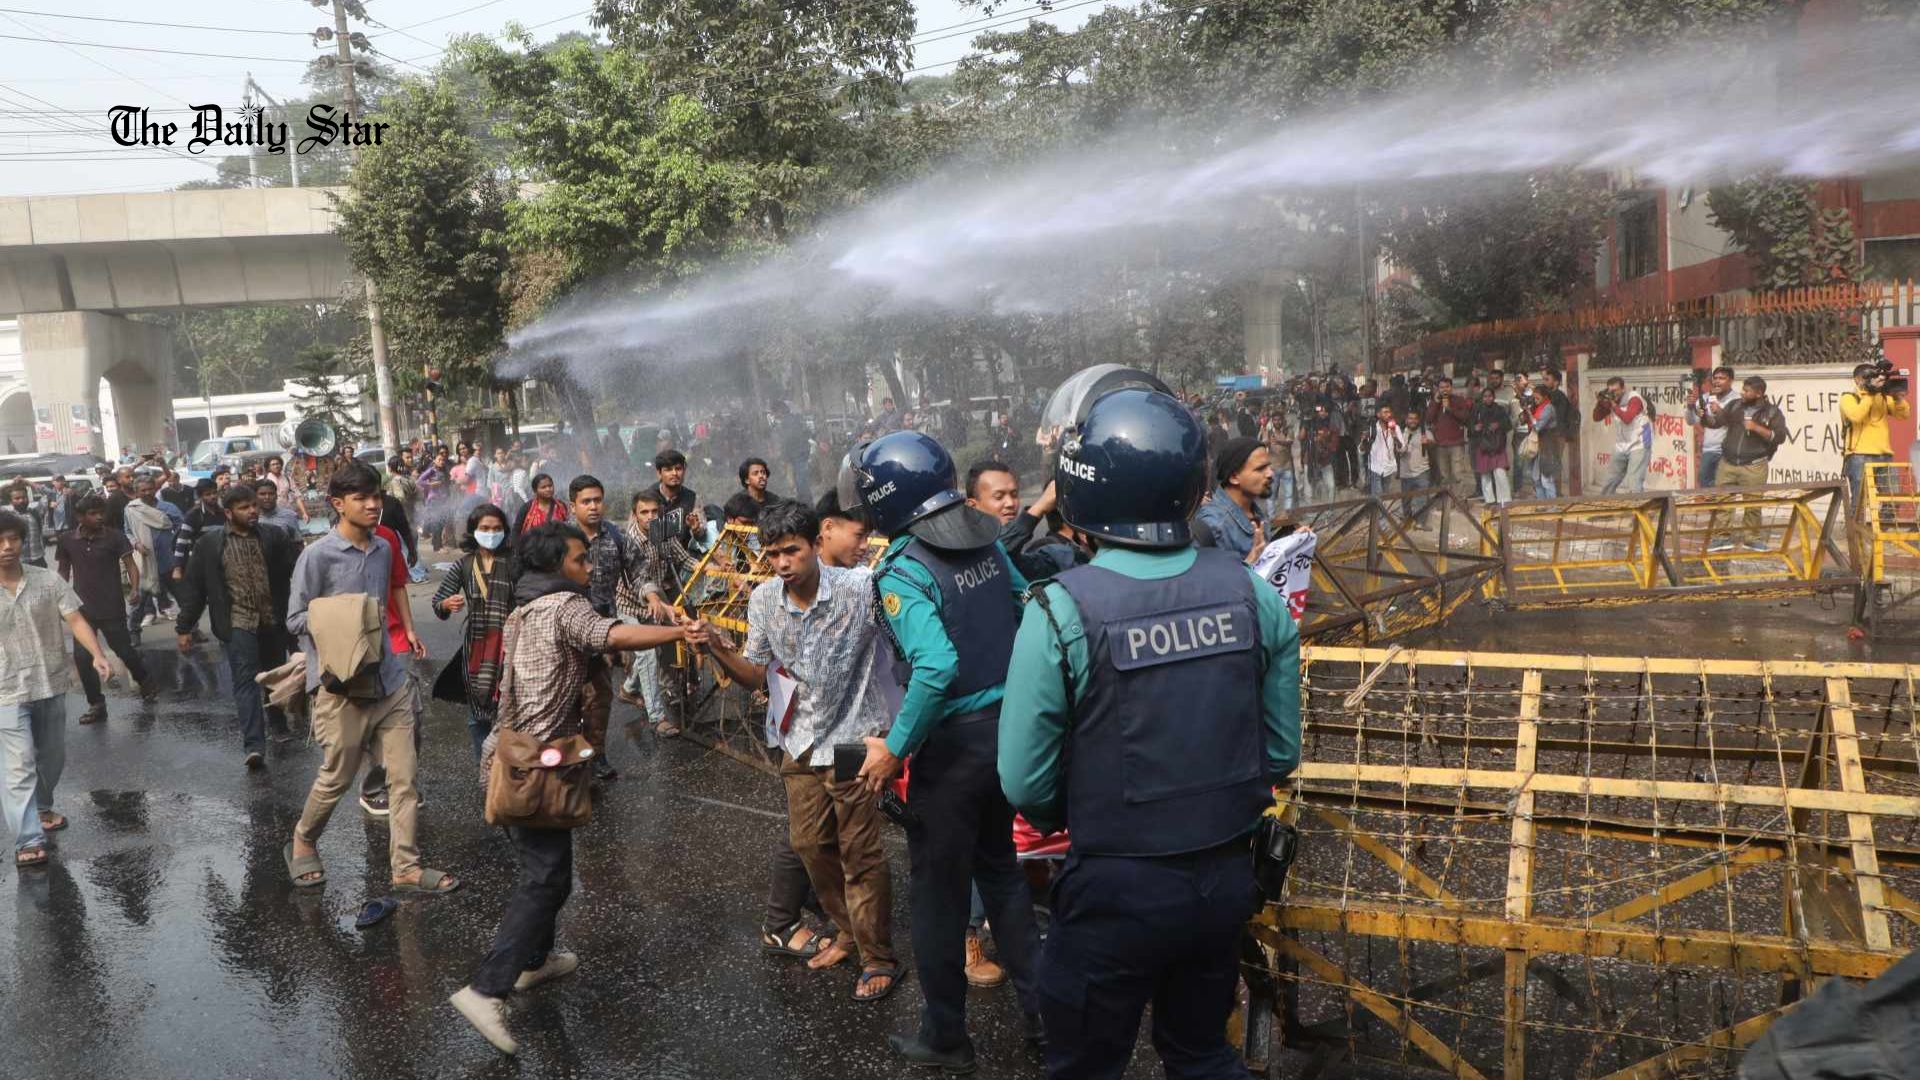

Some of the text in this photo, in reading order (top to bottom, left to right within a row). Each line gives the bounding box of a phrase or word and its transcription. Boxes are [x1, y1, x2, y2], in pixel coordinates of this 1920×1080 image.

[1771, 392, 1839, 413] VE LIF
[1785, 424, 1818, 453] VE
[1060, 454, 1096, 482] POLICE
[1806, 469, 1842, 483] HAYA
[867, 480, 897, 505] POLICE
[953, 556, 1000, 595] POLICE
[1127, 612, 1238, 660] POLICE
